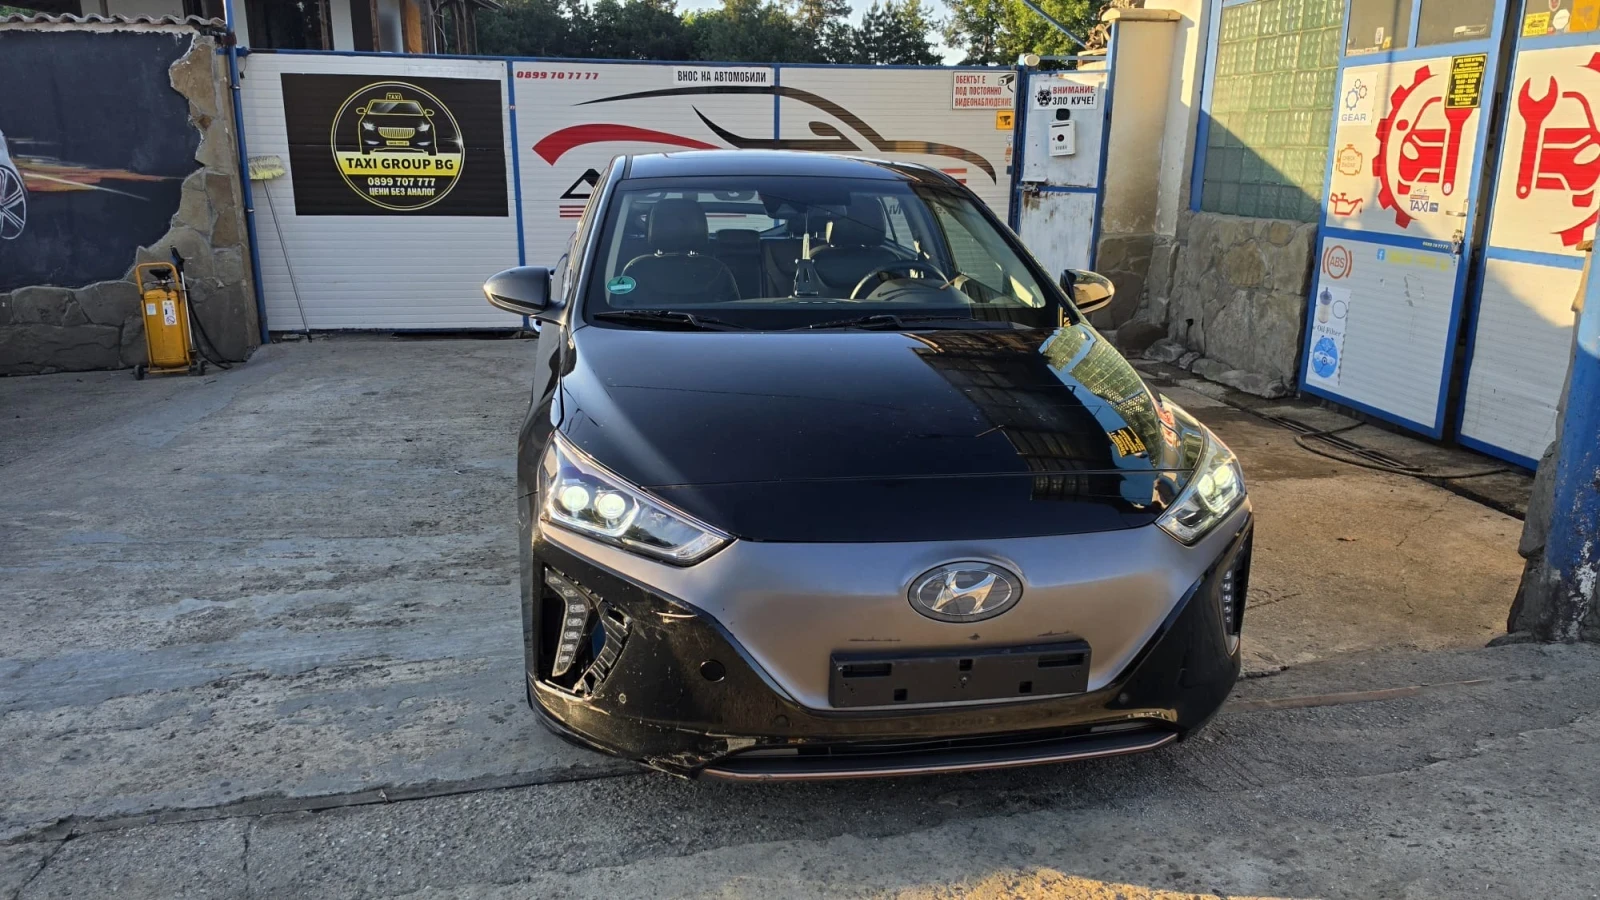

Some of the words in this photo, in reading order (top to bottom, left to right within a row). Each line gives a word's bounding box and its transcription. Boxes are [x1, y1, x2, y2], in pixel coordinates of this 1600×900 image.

[516, 71, 548, 79] 0899
[550, 72, 565, 80] 70
[567, 72, 582, 80] 77
[585, 72, 599, 80] 77
[677, 70, 698, 82] ВНОС
[701, 71, 711, 82] НА
[714, 71, 766, 83] АВТОМОБИЛИ
[955, 75, 980, 84] ОБЕКТЪТ
[982, 75, 986, 84] Е
[955, 86, 967, 96] ПОД
[969, 86, 1002, 95] ПОСТОЯННО
[1052, 86, 1094, 94] ВНИМАНИЕ
[954, 97, 1012, 107] ВИДЕОНАБЛЮДЕНИЕ
[1052, 96, 1068, 105] ЗЛО
[1071, 96, 1094, 105] КУЧЕ!
[1341, 113, 1367, 122] GEAR
[345, 157, 377, 169] TAXI
[381, 158, 431, 170] GROUP
[435, 159, 454, 170] BG
[367, 177, 394, 186] 0899
[395, 177, 415, 186] 707
[416, 177, 436, 187] 777
[369, 187, 390, 197] ЦЕНИ
[390, 187, 406, 196] БЕЗ
[406, 187, 436, 196] АНАЛОГ
[1409, 200, 1429, 213] TAXI
[1330, 256, 1345, 268] ABS
